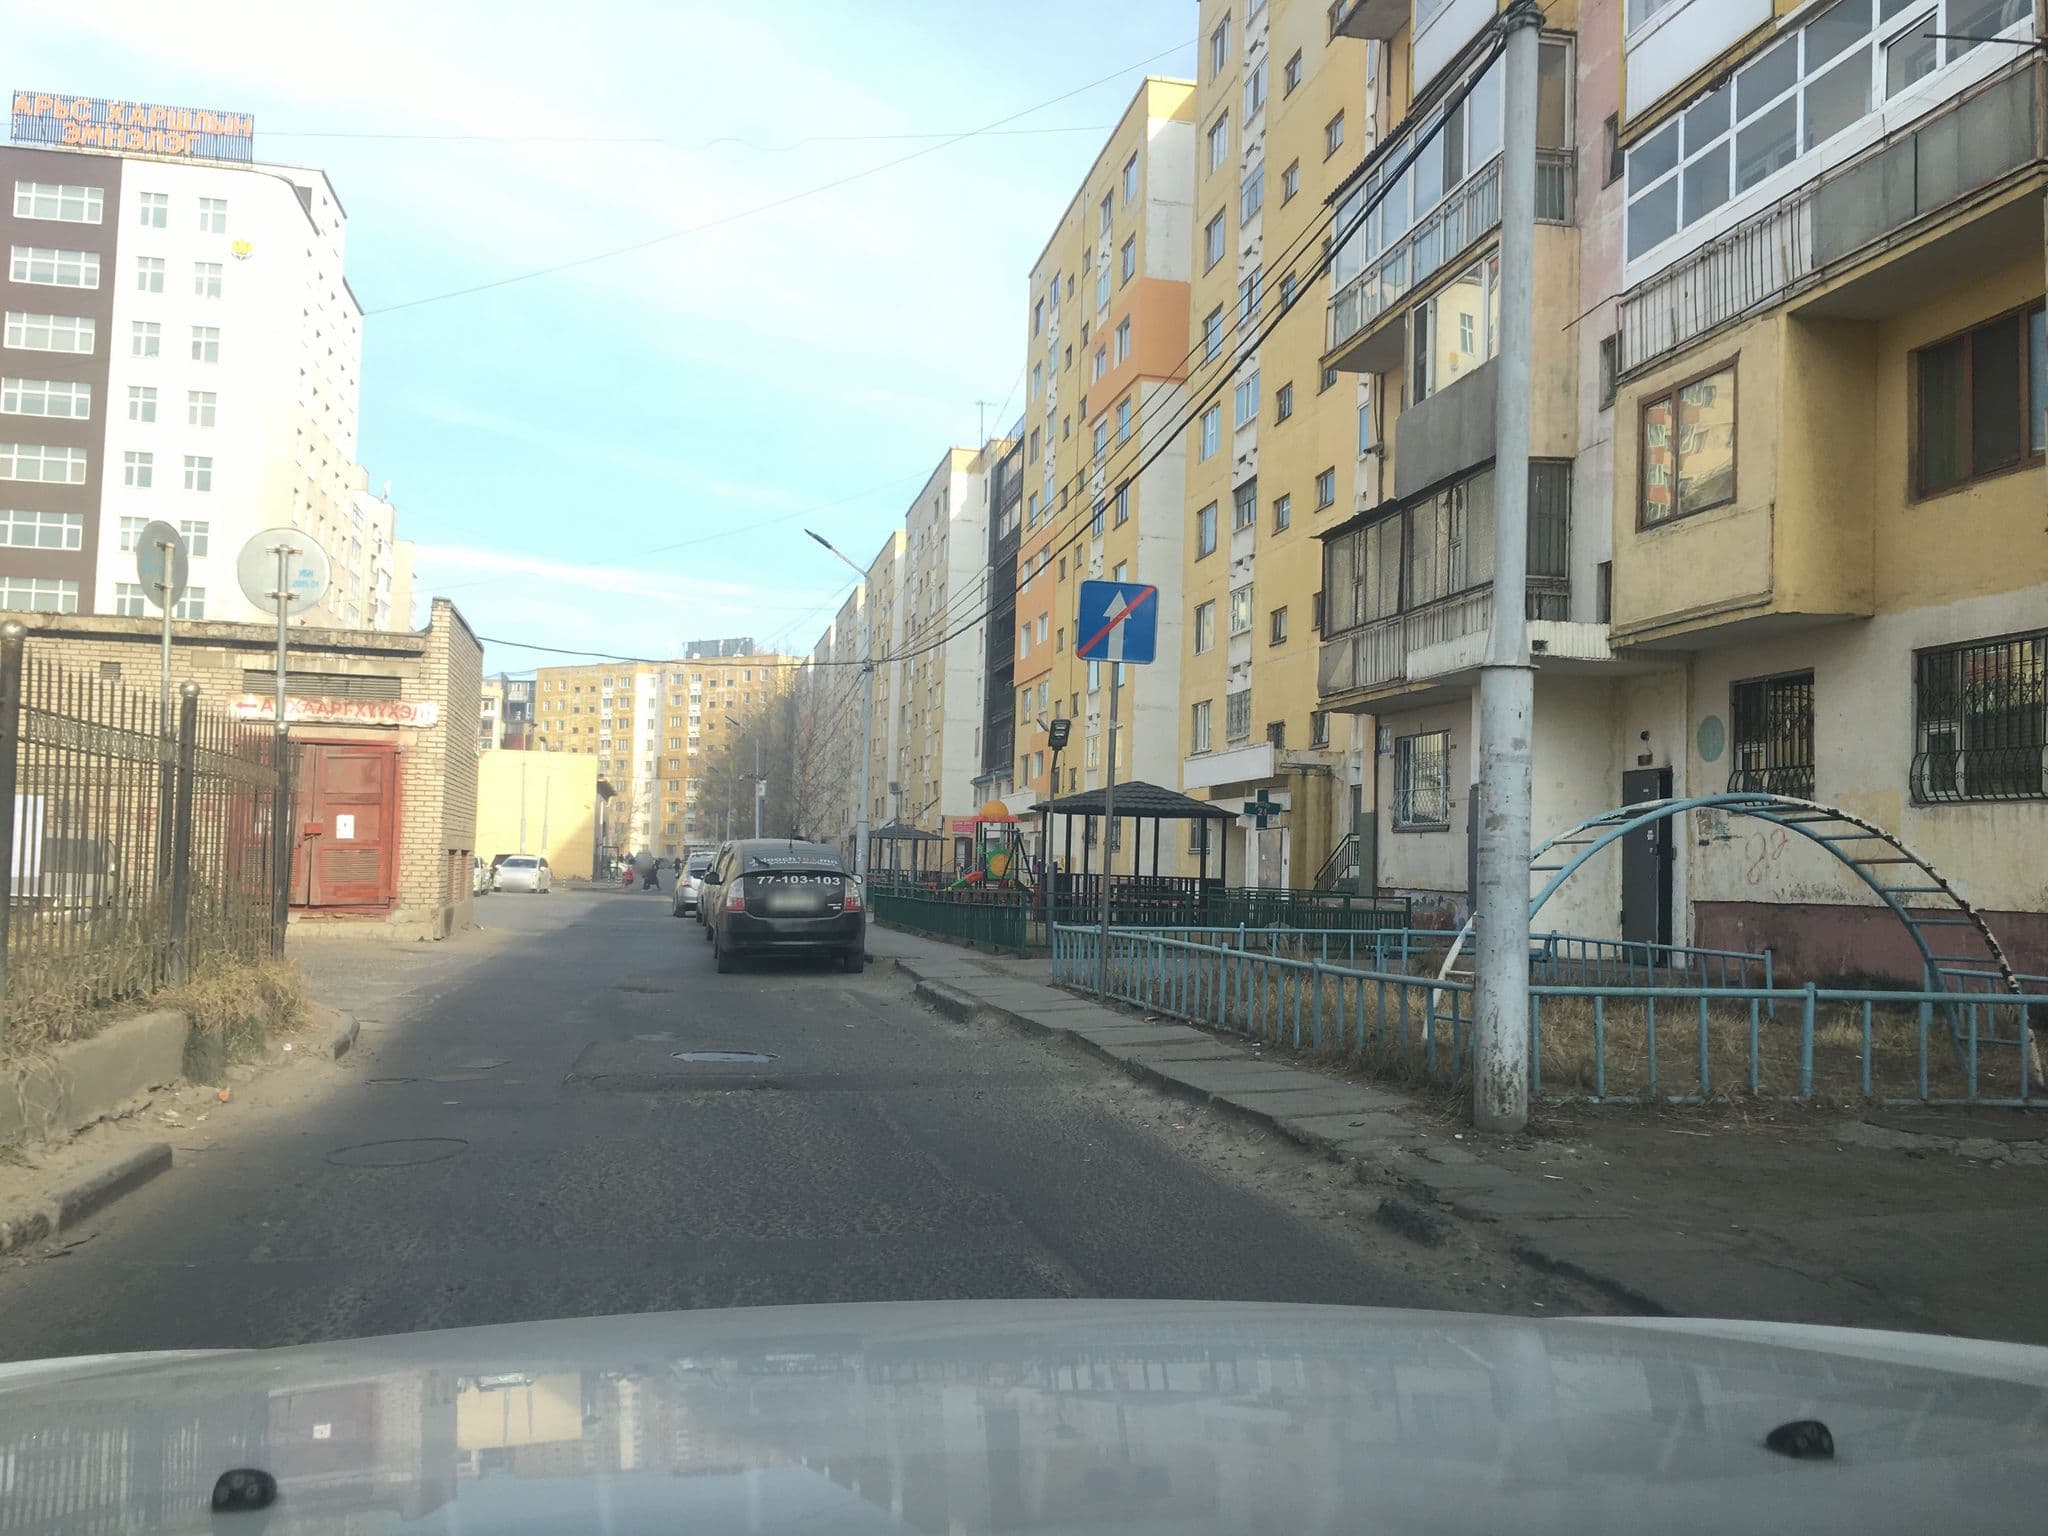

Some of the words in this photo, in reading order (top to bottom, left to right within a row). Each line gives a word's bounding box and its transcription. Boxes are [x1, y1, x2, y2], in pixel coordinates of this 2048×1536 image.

[12, 94, 92, 122] АРЬС
[106, 102, 253, 138] ХАРШЛЫН
[63, 122, 201, 156] ЭМНЭЛЭГ
[757, 875, 841, 886] 77-103-103
